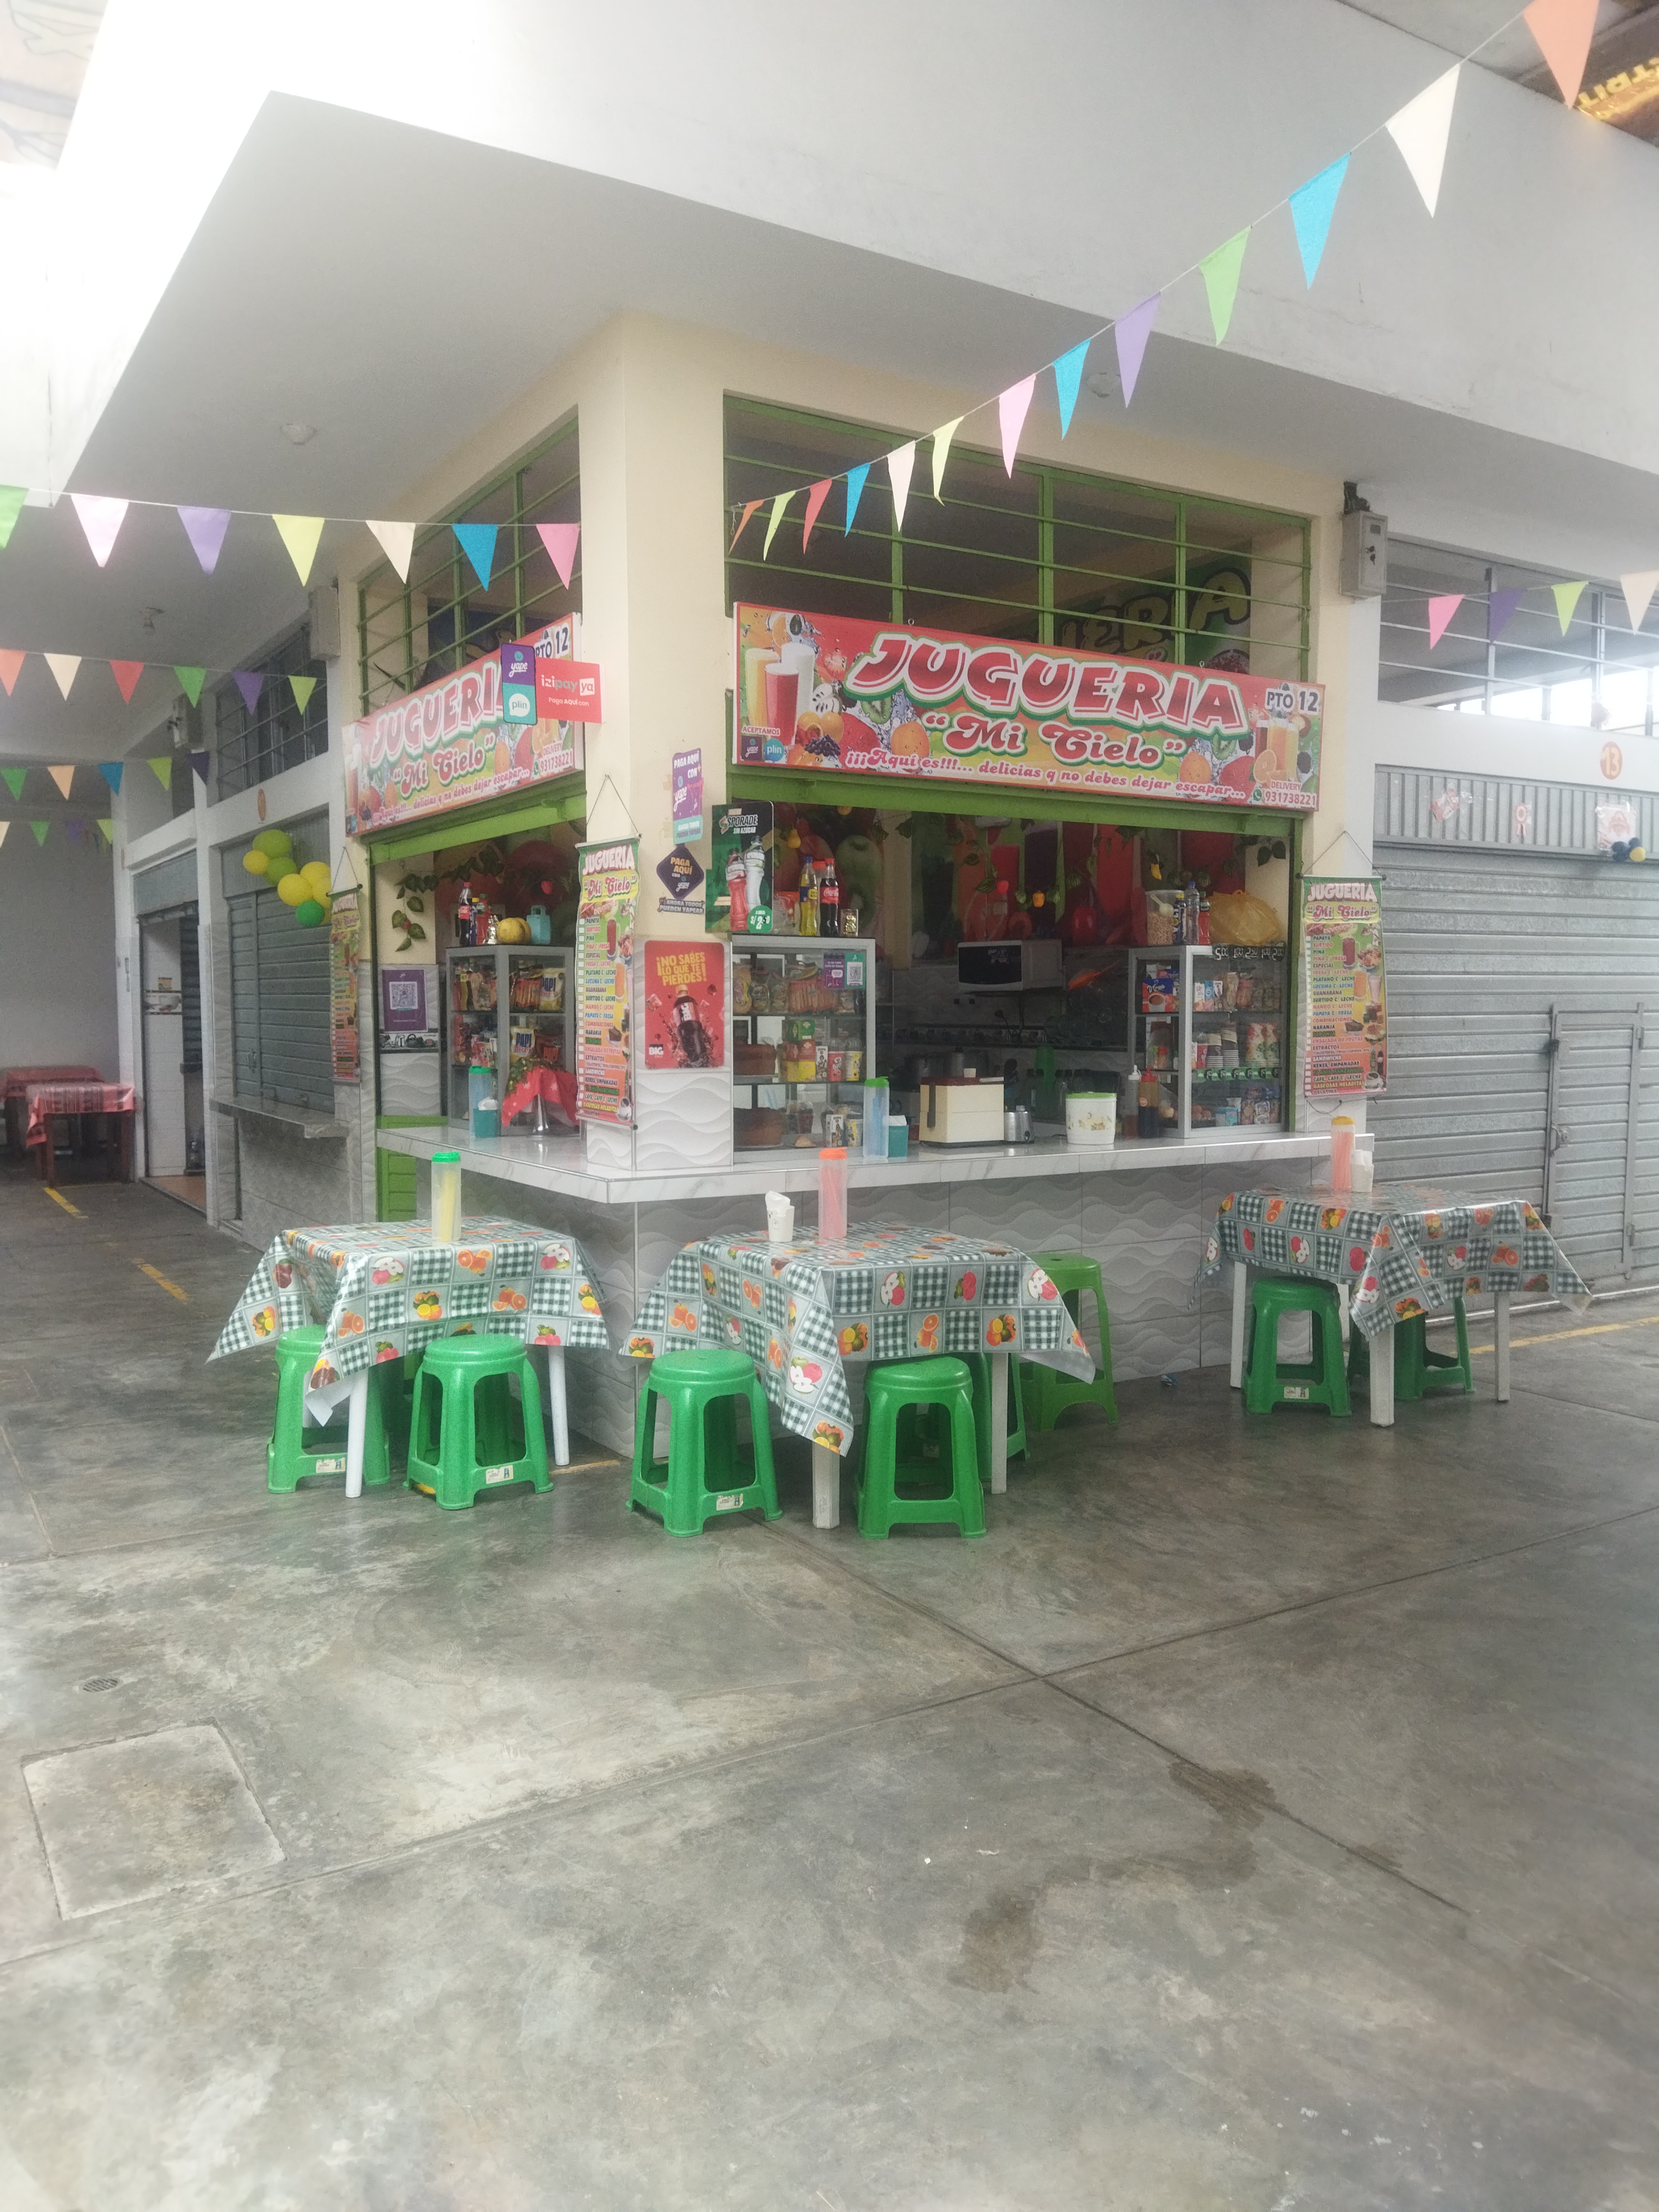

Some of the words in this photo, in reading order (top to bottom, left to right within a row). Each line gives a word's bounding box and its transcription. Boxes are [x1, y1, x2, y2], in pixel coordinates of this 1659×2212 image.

[556, 627, 568, 655] 12
[509, 662, 528, 677] yape
[541, 675, 578, 692] izipay
[581, 682, 593, 693] ya
[848, 636, 1246, 732] JUGUERIA
[512, 701, 527, 710] plin
[1267, 691, 1293, 708] PTO
[1300, 691, 1318, 712] 12
[742, 726, 780, 735] ACEPTAMOS
[544, 742, 562, 756] DELIVERY
[745, 746, 759, 758] yape
[766, 744, 782, 755] plin
[540, 751, 572, 773] 931738221
[674, 757, 687, 769] PAGA
[1601, 746, 1621, 777] 13
[687, 768, 697, 779] CON
[979, 760, 1041, 778] delicias
[1047, 771, 1055, 783] q
[1061, 771, 1079, 782] no
[1085, 771, 1128, 787] debes
[1132, 774, 1171, 792] dejar
[444, 791, 452, 801] no
[453, 783, 471, 798] debes
[474, 778, 492, 793] dejar
[1271, 781, 1301, 791] DELIVERY
[674, 786, 687, 812] yape
[1265, 791, 1317, 806] 931738221
[727, 814, 759, 827] SPORADE
[582, 844, 635, 875] JUGUERIA
[670, 857, 690, 867] PAGA
[676, 882, 690, 892] yape
[1307, 882, 1378, 902] JUGUERIA
[679, 952, 705, 965] SABES
[662, 967, 672, 976] LO
[674, 964, 689, 974] QUE
[692, 963, 701, 972] TE
[649, 1046, 663, 1055] BIG
